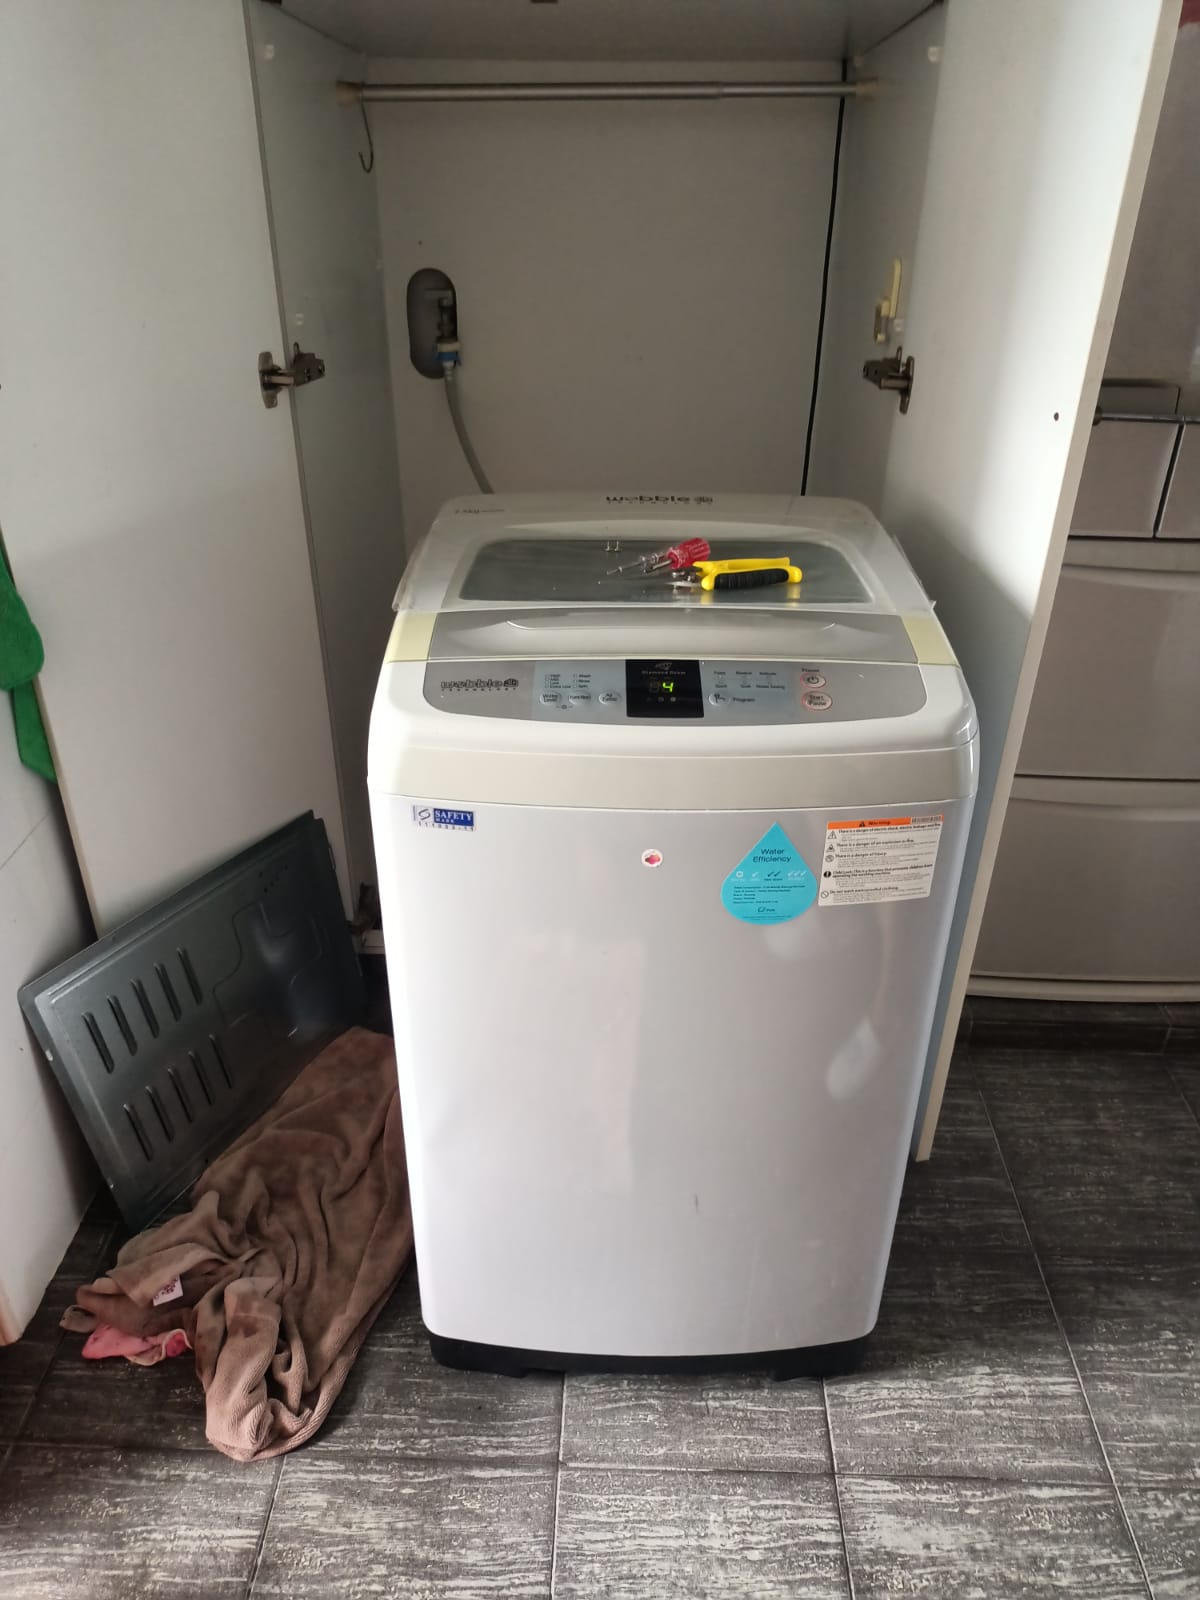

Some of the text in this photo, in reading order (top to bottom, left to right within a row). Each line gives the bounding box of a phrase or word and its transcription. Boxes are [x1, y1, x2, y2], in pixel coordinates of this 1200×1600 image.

[662, 681, 674, 693] 4
[435, 809, 472, 821] SAFETY
[752, 855, 792, 864] Efficiency
